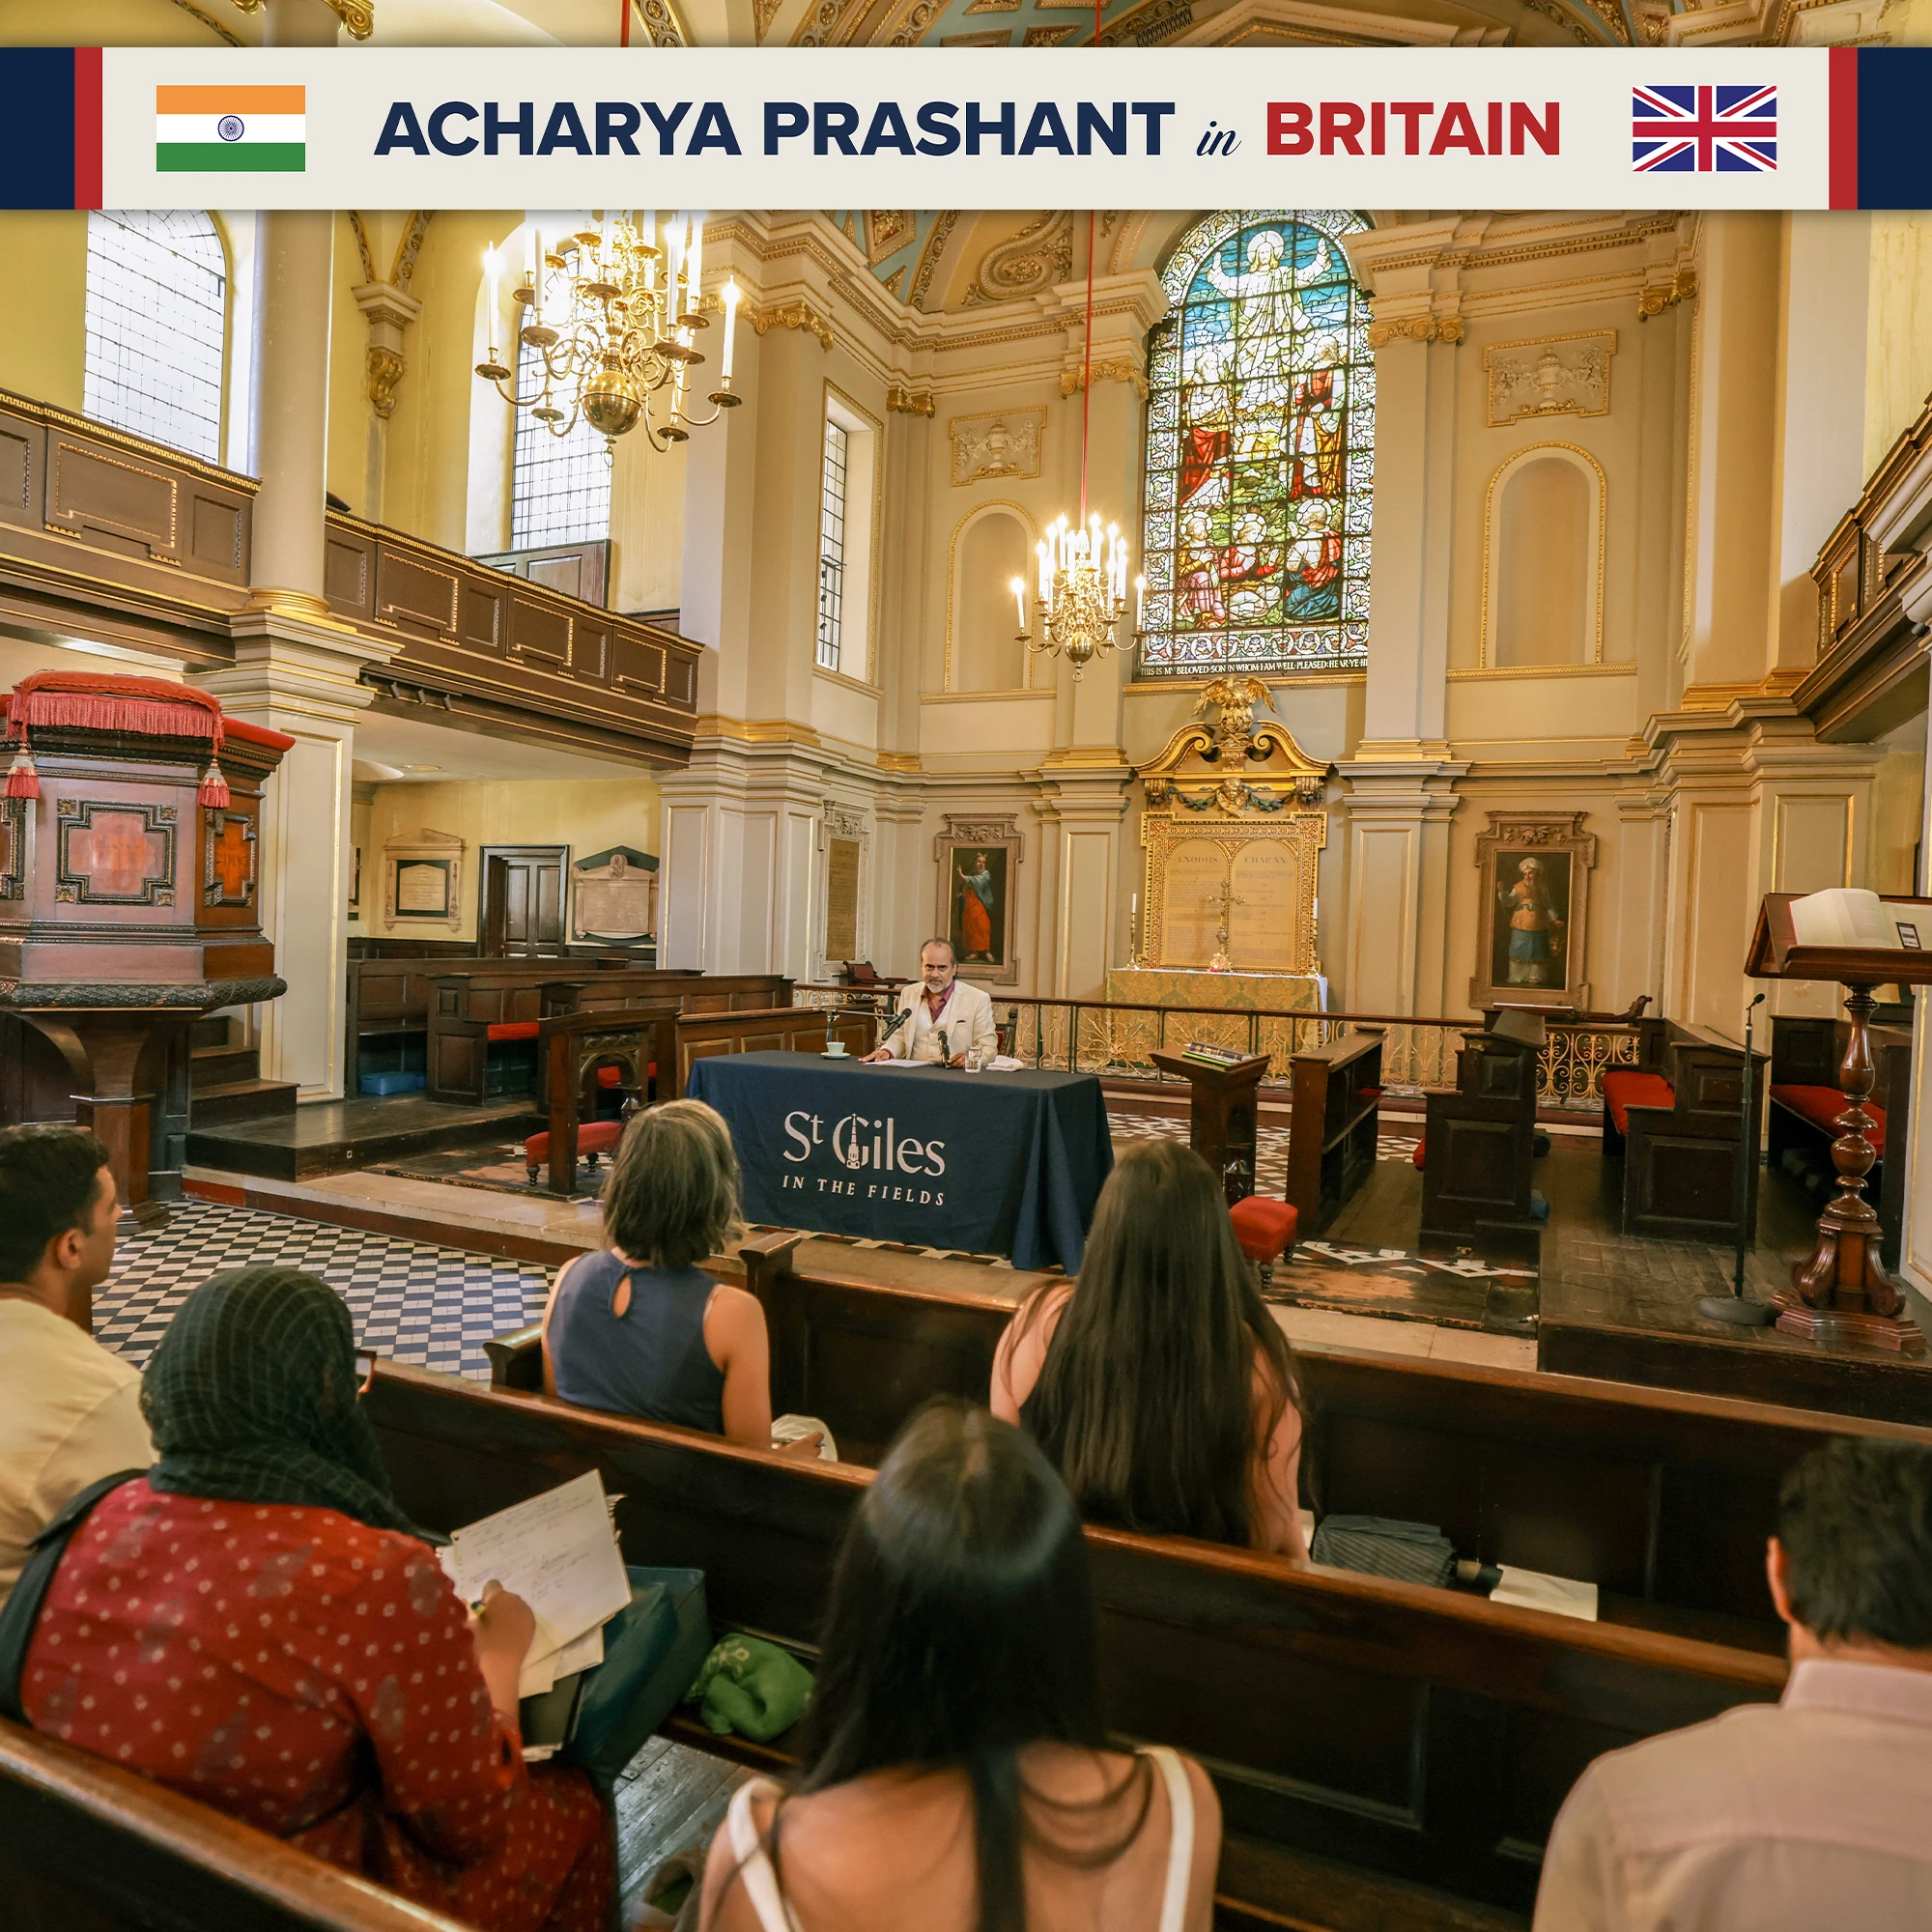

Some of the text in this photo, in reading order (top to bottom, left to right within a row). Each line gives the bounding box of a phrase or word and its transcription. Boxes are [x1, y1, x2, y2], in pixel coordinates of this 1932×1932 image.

[1141, 667, 1155, 676] THIS
[1156, 667, 1163, 675] IS
[1177, 665, 1209, 675] BELOVED
[1210, 664, 1227, 674] SON
[1236, 663, 1259, 672] WHOM
[1264, 662, 1276, 671] AM
[1277, 661, 1295, 670] WELL
[1350, 658, 1359, 668] YE
[782, 1111, 946, 1177] St Giles
[782, 1175, 944, 1207] IN THE FIELDS
